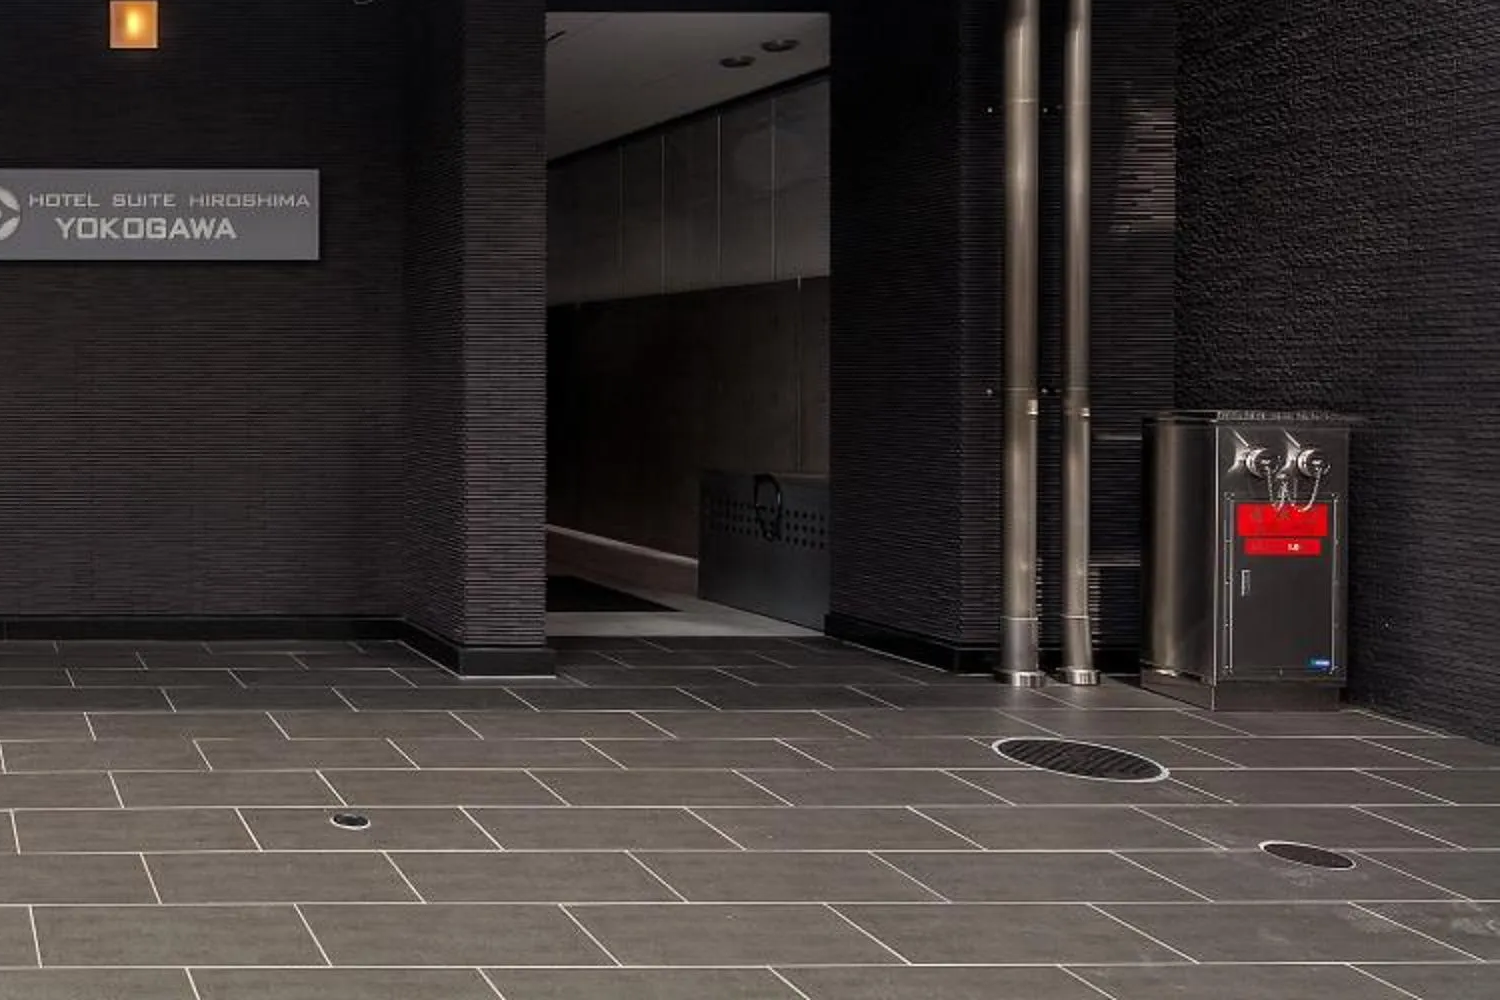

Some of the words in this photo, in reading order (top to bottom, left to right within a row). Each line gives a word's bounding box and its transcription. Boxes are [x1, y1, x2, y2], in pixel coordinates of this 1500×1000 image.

[28, 192, 101, 208] HOTEL
[111, 192, 177, 208] SUITE
[188, 192, 310, 208] HIROSHIMA
[54, 217, 238, 240] YOKOGAWA
